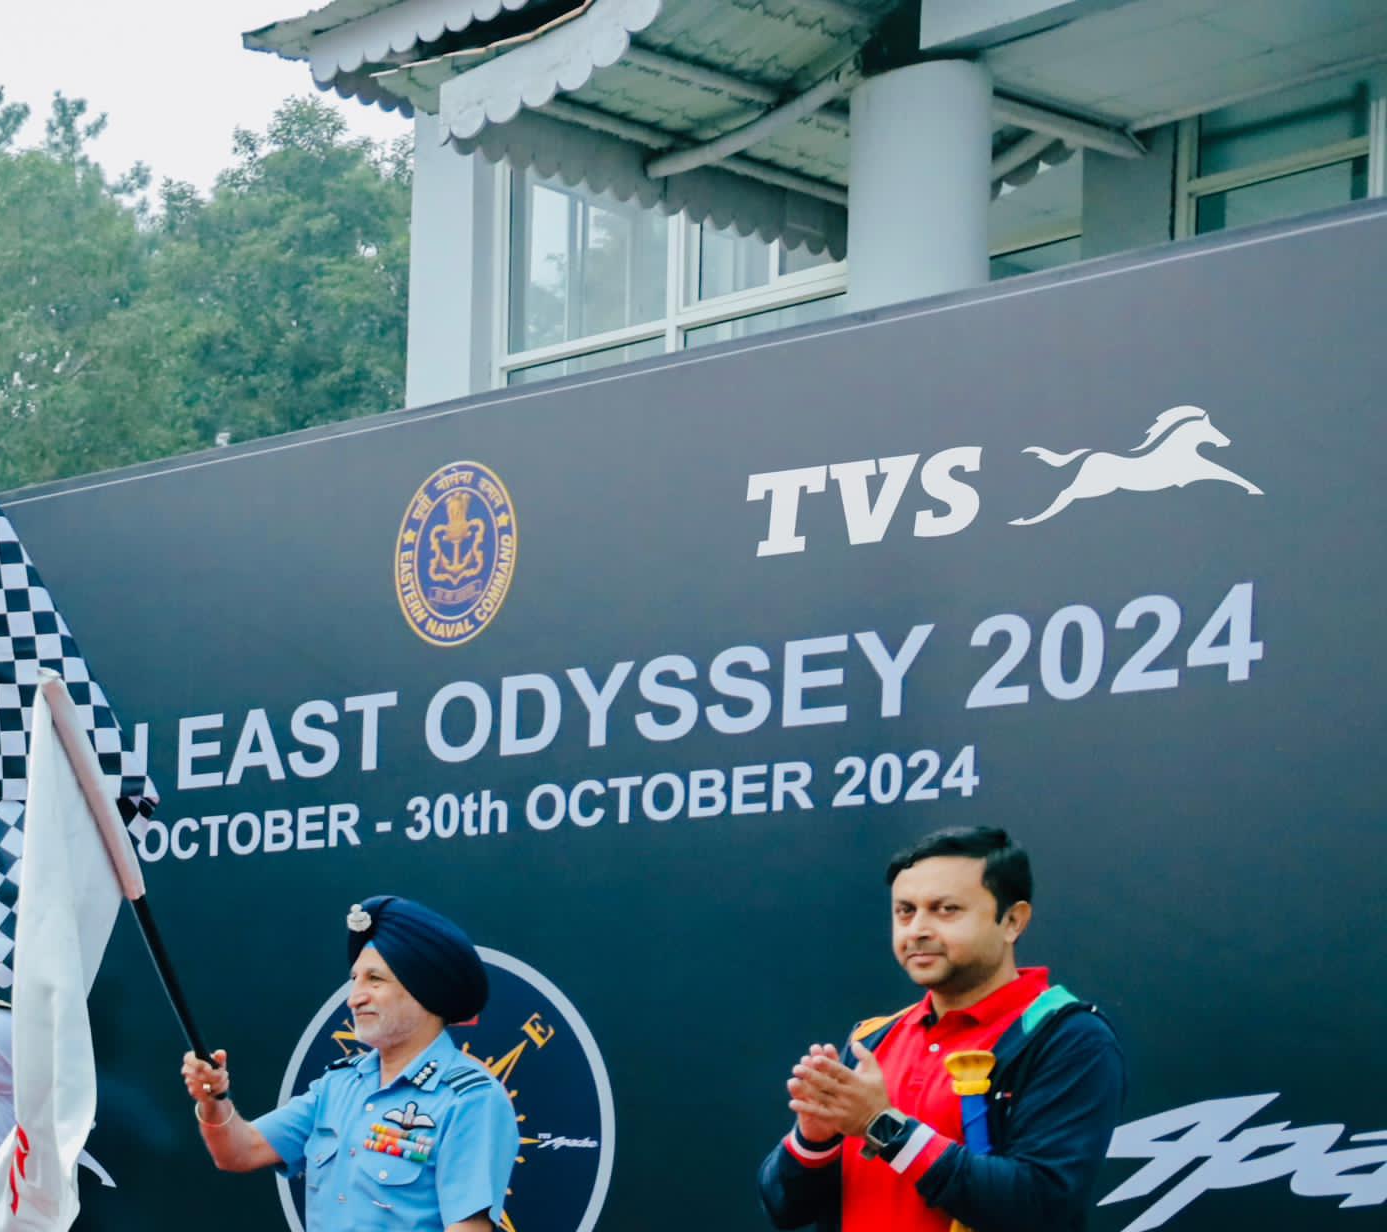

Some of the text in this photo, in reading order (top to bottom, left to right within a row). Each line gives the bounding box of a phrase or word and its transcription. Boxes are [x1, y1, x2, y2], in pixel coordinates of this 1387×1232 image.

[747, 446, 983, 557] TVS
[400, 534, 513, 639] EASTERN NAVAL COMMAND
[178, 582, 1264, 790] EAST ODYSSEY 2024
[137, 803, 361, 862] OCTOBER
[405, 790, 508, 841] 30th
[526, 760, 814, 831] OCTOBER
[832, 745, 980, 808] 2024
[523, 1012, 555, 1049] E
